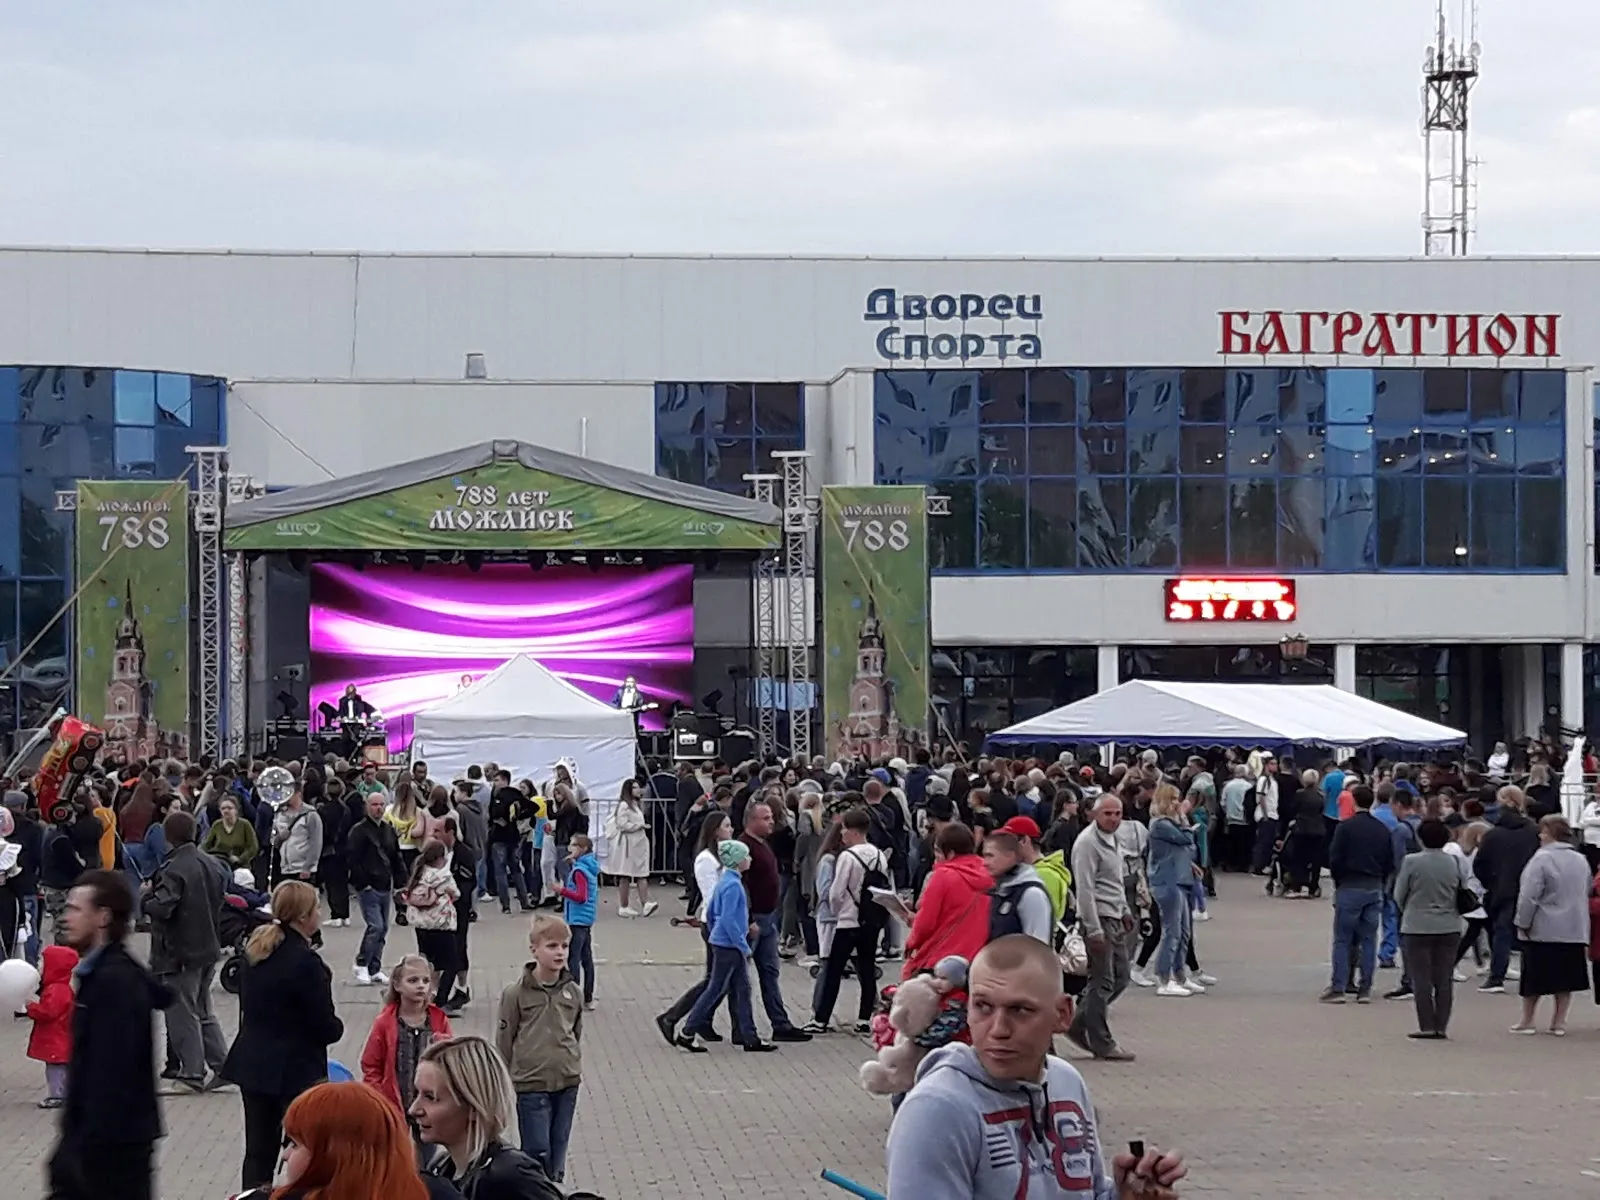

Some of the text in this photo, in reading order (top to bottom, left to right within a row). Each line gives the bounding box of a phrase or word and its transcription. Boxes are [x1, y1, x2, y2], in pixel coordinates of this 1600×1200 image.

[864, 288, 1043, 320] Дворец
[876, 326, 1042, 361] Спорта
[1217, 311, 1561, 357] БАГРАТИОН
[455, 485, 498, 507] 788
[98, 516, 171, 551] 788
[428, 506, 575, 532] МОЖАЙСК
[843, 519, 911, 553] 788
